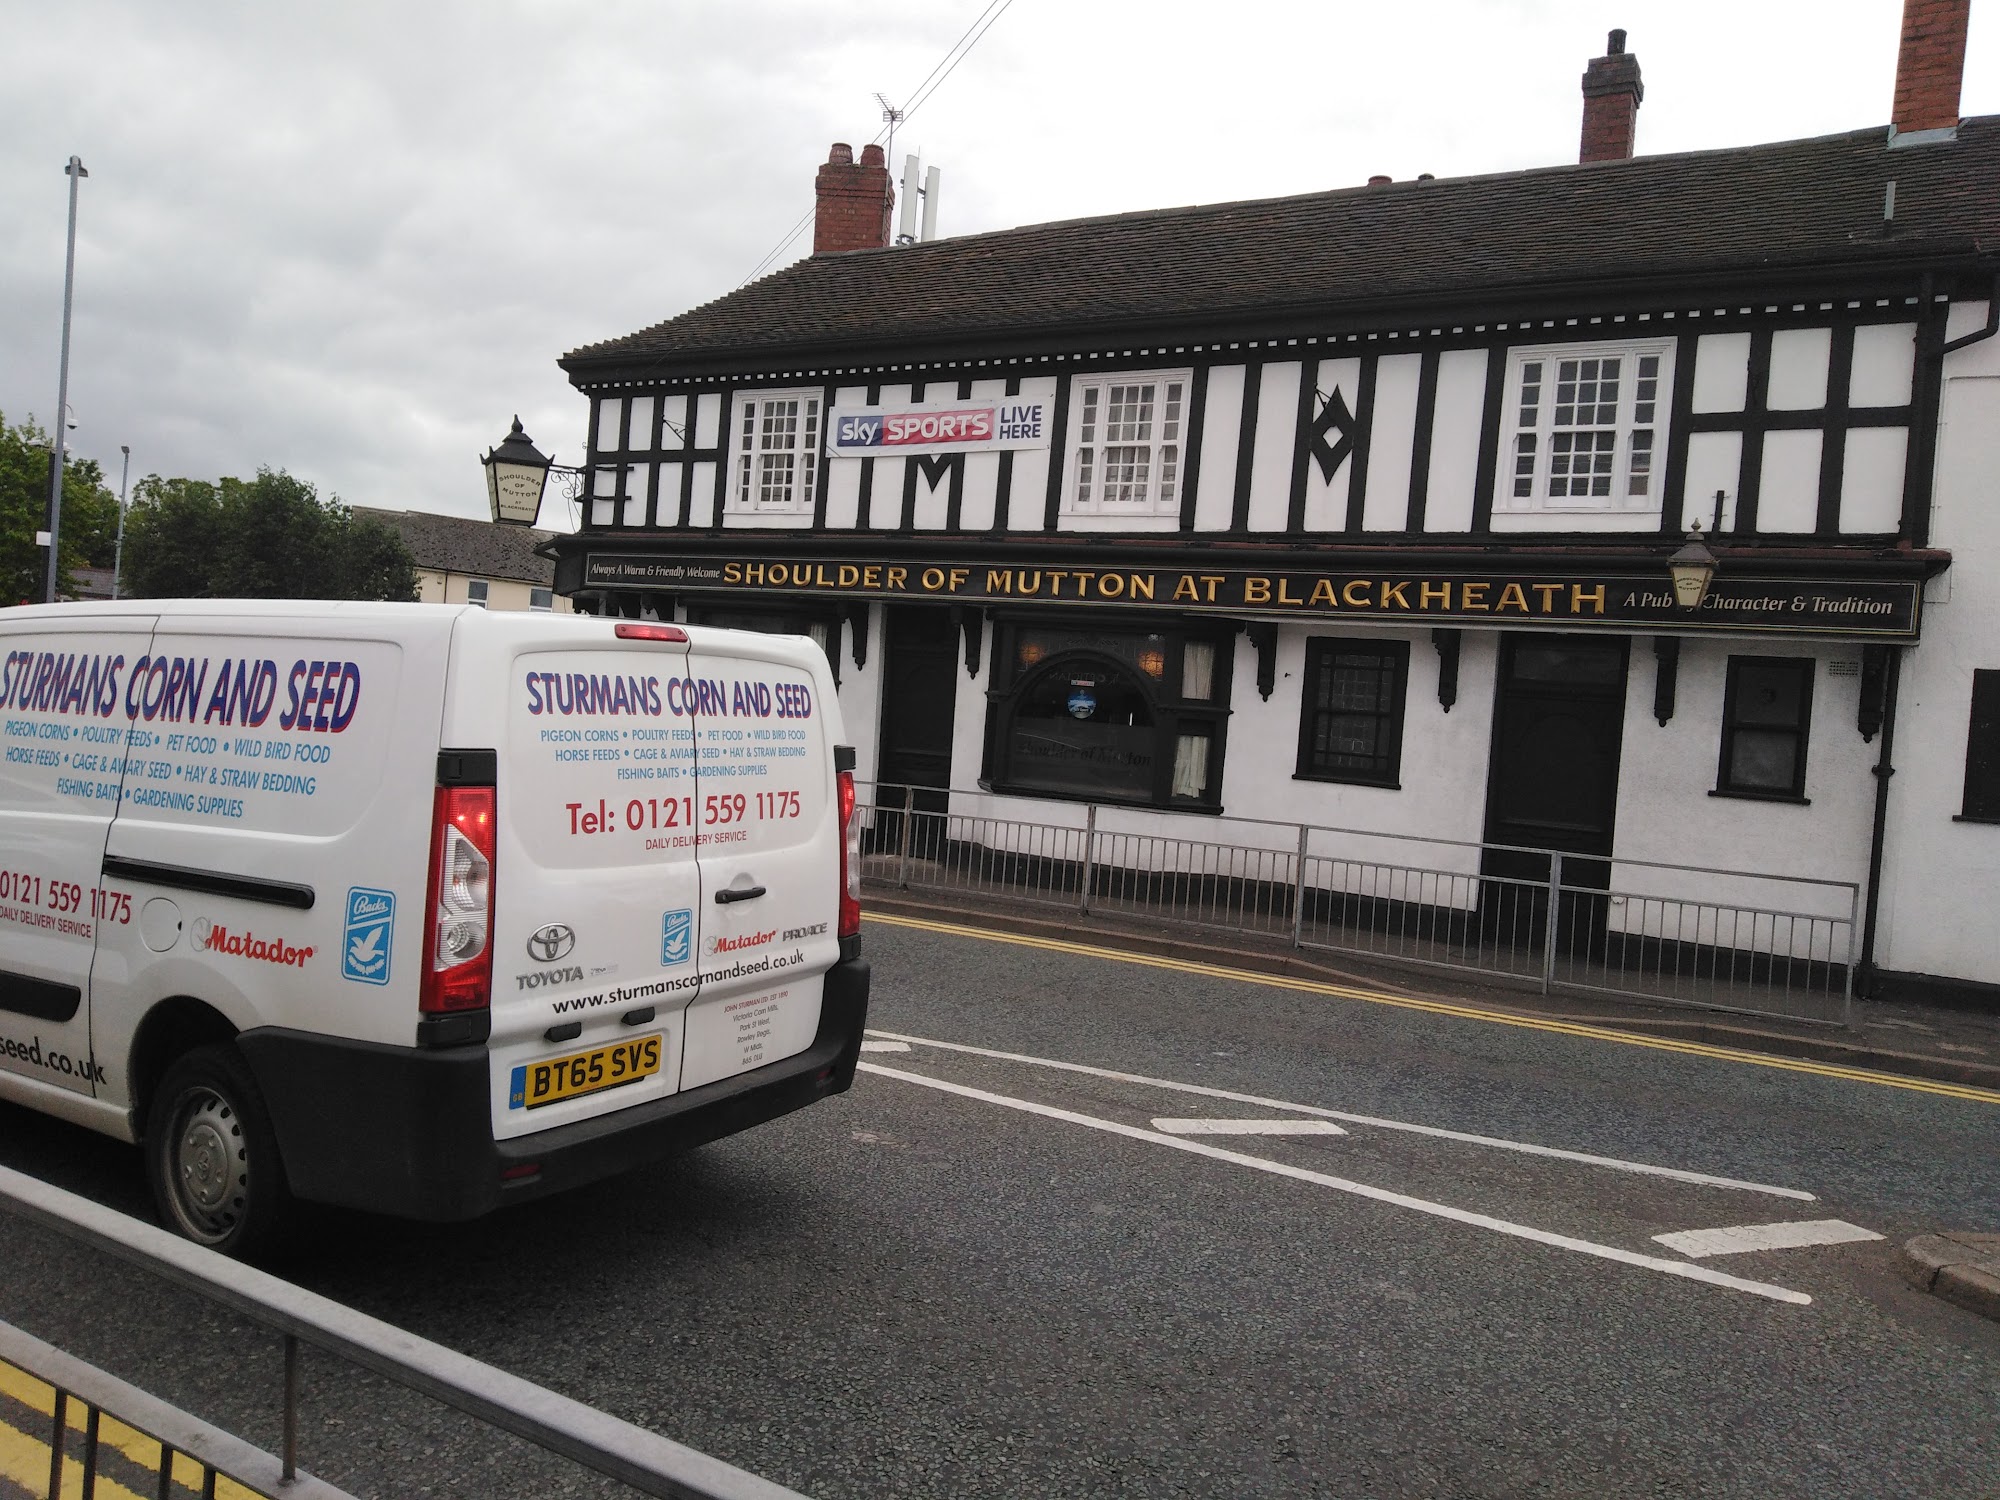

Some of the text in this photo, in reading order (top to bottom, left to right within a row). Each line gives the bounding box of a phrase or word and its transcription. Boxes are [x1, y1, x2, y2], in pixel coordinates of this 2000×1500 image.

[1000, 405, 1043, 423] LIVE
[842, 413, 989, 445] sky SPORTS
[999, 424, 1042, 440] HERE
[499, 474, 541, 487] SHOULDER
[502, 487, 537, 497] MUTTON
[590, 563, 720, 579] Always A Warm & Friendly Welcome
[723, 562, 1606, 615] SHOULDER OF MUTTON AT BLACKHEATH
[1624, 592, 1672, 608] A Pub
[1702, 593, 1893, 615] Character & Tradition
[0, 651, 361, 733] STURMANS CORN AND SEED
[526, 671, 812, 719] STURMANS CORN AND SEED
[5, 720, 331, 763] PIGEON CORNS POULTRY FEEDS PET FOOD WILD BIRD FOOD
[541, 729, 806, 742] PIGEON CORNS POULTRY FEEDS PET FOOD WILD BIRD FOOD
[555, 746, 806, 762] HORSE FEEDS CAGE & AVIARY SEED HAY & STRAW BEDDING
[5, 746, 316, 795] HORSE FEEDS CAGE & AVIARY SEED HAY & STRAW BEDDING
[617, 764, 767, 780] FISHING BAITS GARDENING SUPPLIES
[56, 778, 243, 818] FISHING BAITS GARDENING SUPPLIES
[566, 790, 800, 834] Tel: 0121 559 1175
[645, 831, 747, 850] DAILY DELIVERY SERVICE
[0, 870, 132, 924] 0121 559 1175
[0, 906, 91, 938] DAILY DELIVERY SERVICE
[205, 925, 314, 967] Matador
[713, 930, 776, 953] Matador
[516, 966, 584, 990] TOYOTA
[552, 948, 805, 1014] www.sturmanscornandseed.co.uk
[724, 1004, 738, 1013] JOHN
[738, 998, 760, 1010] STURMAN
[533, 1040, 658, 1097] BT65 SVS
